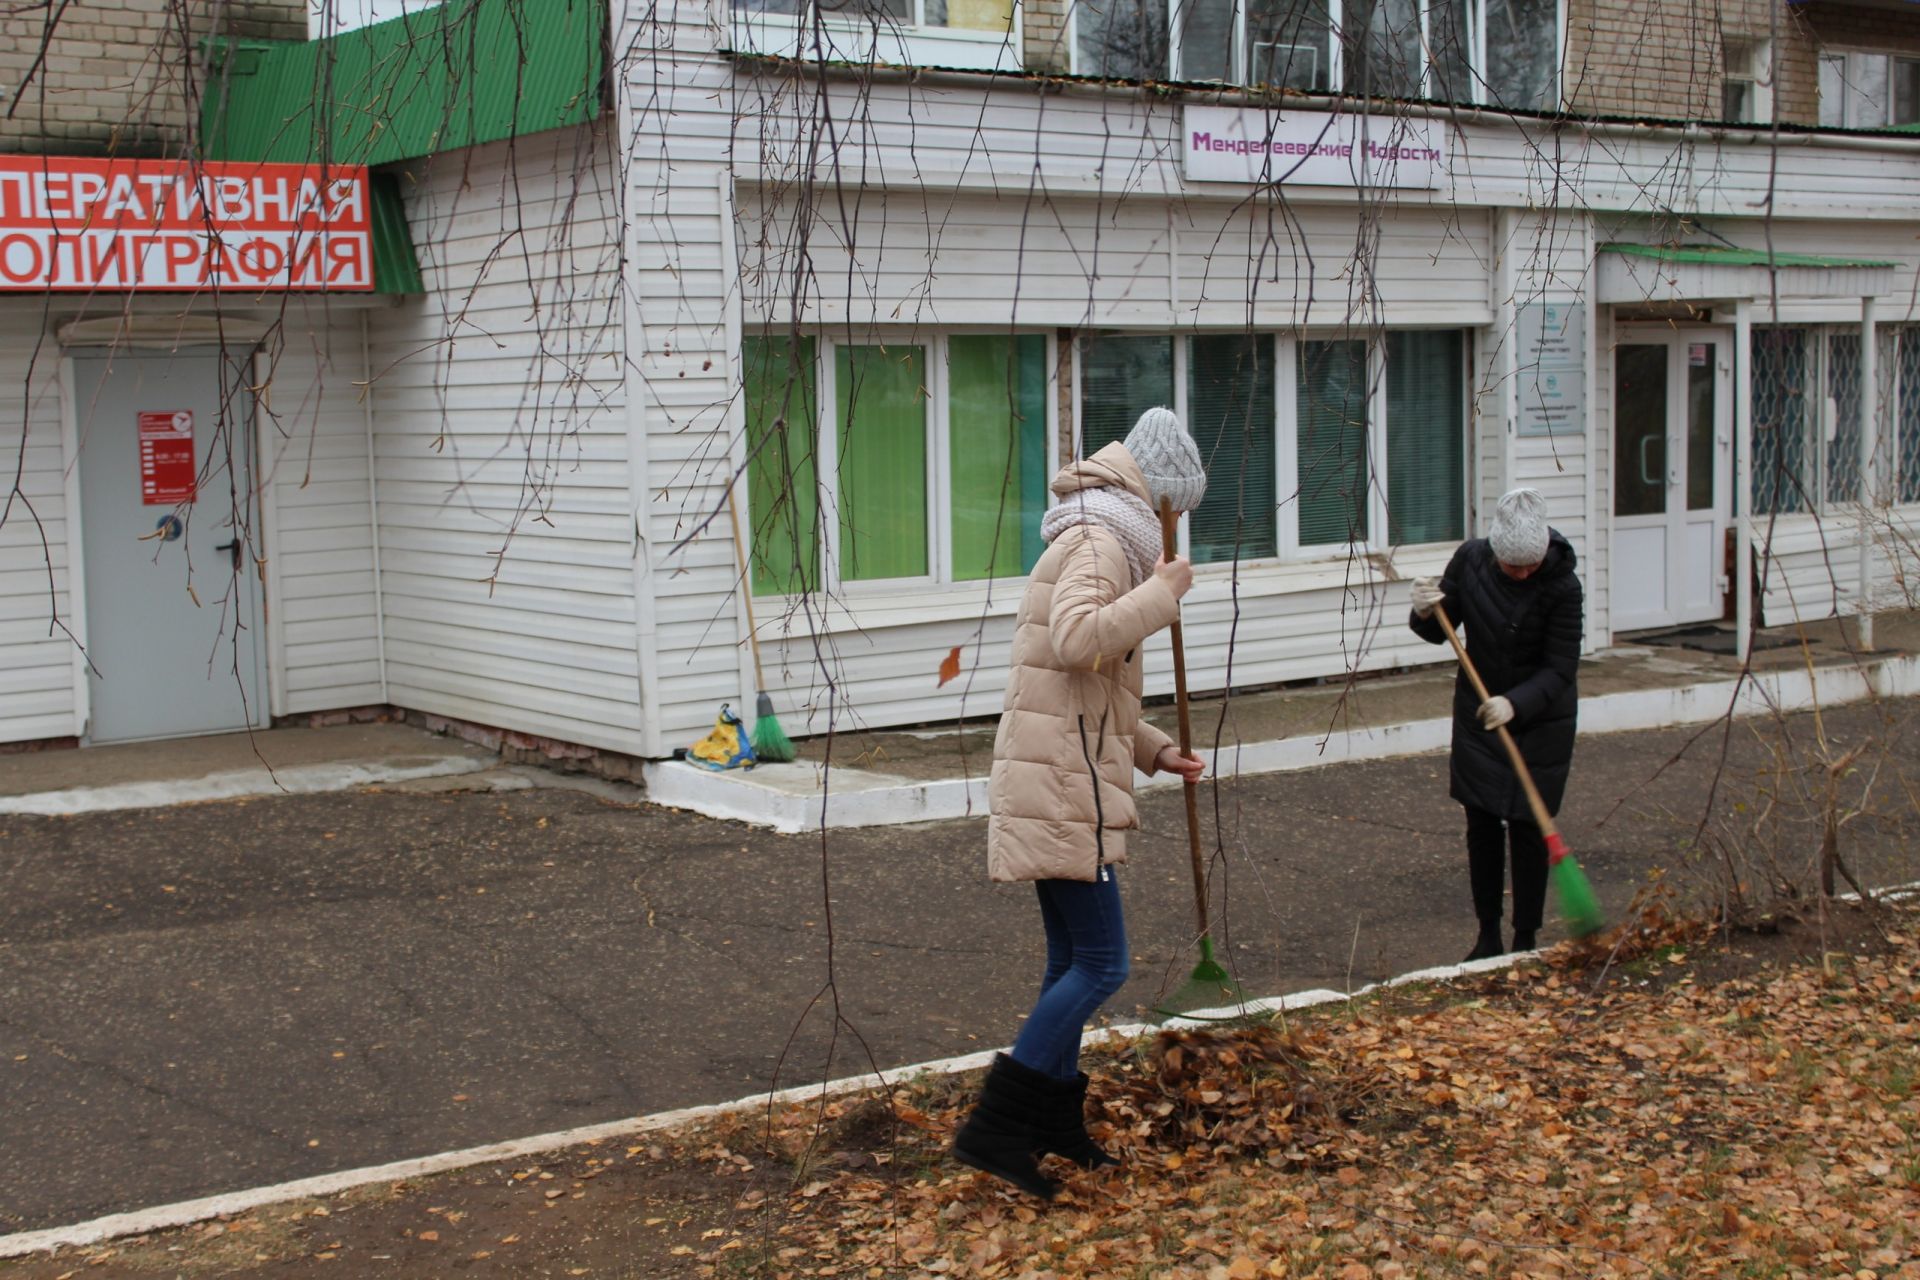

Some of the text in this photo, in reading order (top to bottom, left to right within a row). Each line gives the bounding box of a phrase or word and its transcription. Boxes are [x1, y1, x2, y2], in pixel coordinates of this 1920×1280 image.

[1360, 140, 1441, 161] Новости
[0, 171, 363, 223] ПЕРАТИВНАЯ
[0, 233, 363, 283] ОЛИГРАФИЯ
